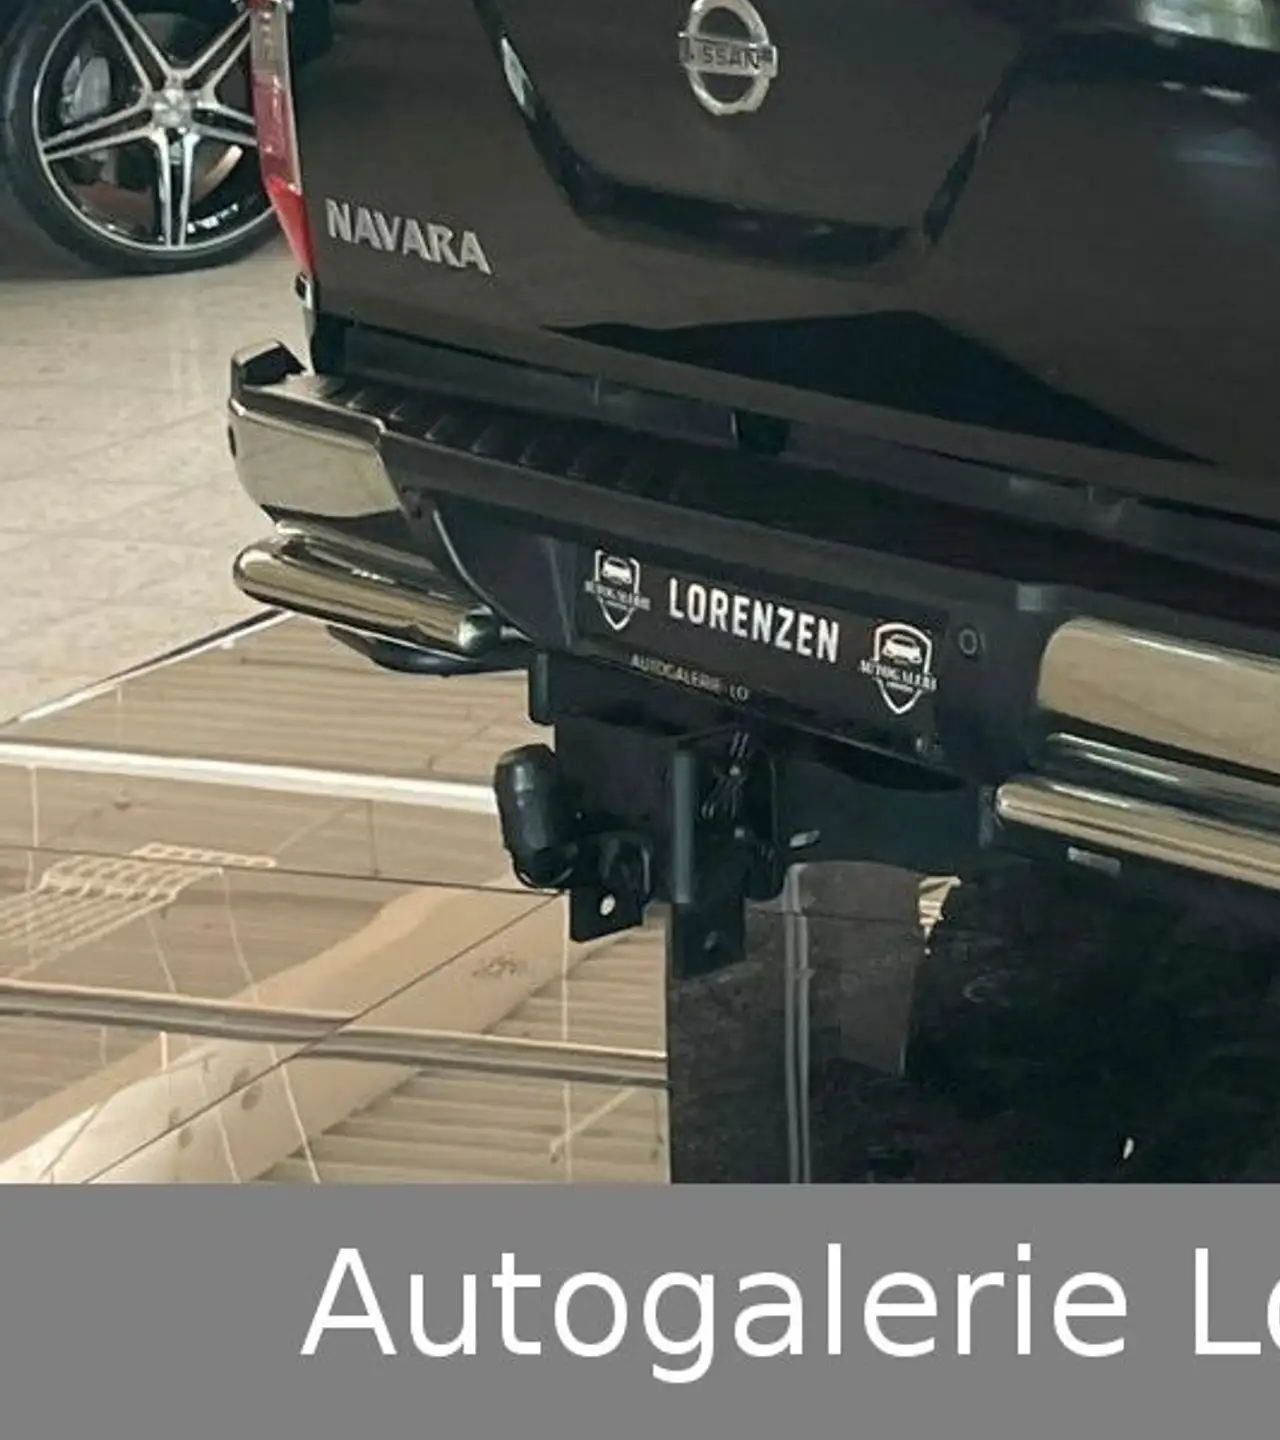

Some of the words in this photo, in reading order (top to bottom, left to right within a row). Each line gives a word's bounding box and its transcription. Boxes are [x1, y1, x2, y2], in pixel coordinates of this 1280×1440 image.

[686, 42, 762, 71] SSAN
[325, 197, 492, 275] NAVARA
[668, 577, 839, 664] LORENZEN
